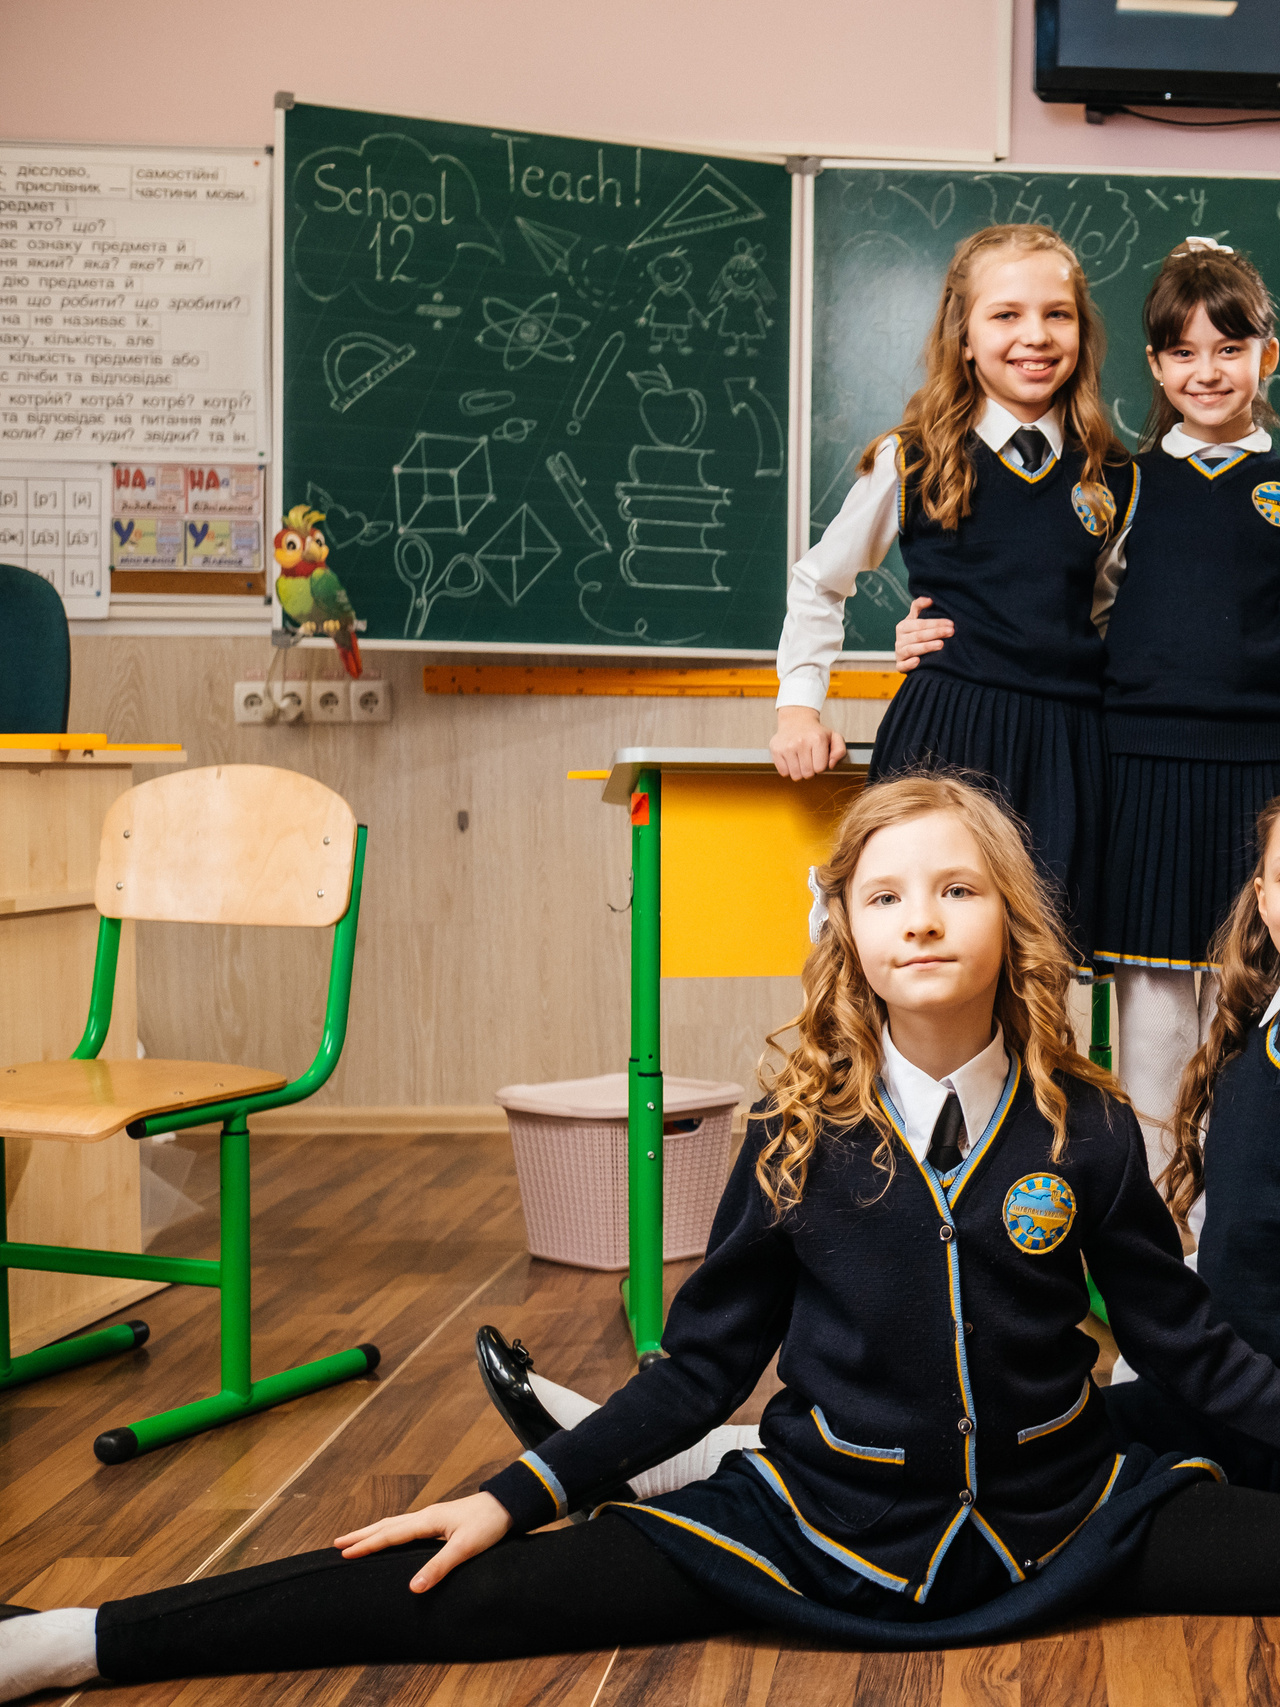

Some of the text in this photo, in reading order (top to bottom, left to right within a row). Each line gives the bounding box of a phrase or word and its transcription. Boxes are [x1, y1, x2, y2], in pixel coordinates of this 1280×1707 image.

[491, 132, 642, 207] Teach!
[136, 188, 197, 199] частини
[313, 163, 455, 226] School
[27, 217, 63, 232] хто?
[72, 219, 106, 234] що?
[27, 240, 83, 255] ознаку
[92, 241, 167, 255] предмета
[369, 222, 418, 283] 12
[28, 255, 74, 270] який?
[84, 257, 120, 270] яка?
[39, 276, 115, 290] предмета
[27, 296, 52, 308] що
[61, 293, 126, 310] робити?
[135, 298, 159, 311] що
[169, 296, 241, 312] зробити?
[34, 316, 53, 326] не
[63, 316, 126, 327] називає
[126, 335, 154, 346] але
[9, 352, 200, 367] кількість предметів або
[17, 369, 58, 382] лічби
[66, 372, 82, 383] та
[91, 371, 172, 386] відповідає
[2, 411, 236, 427] та відповідає на питання як?
[2, 426, 46, 440] коли?
[54, 426, 82, 442] де?
[91, 426, 135, 444] куди?
[144, 428, 199, 444] звідки?
[208, 431, 225, 443] та
